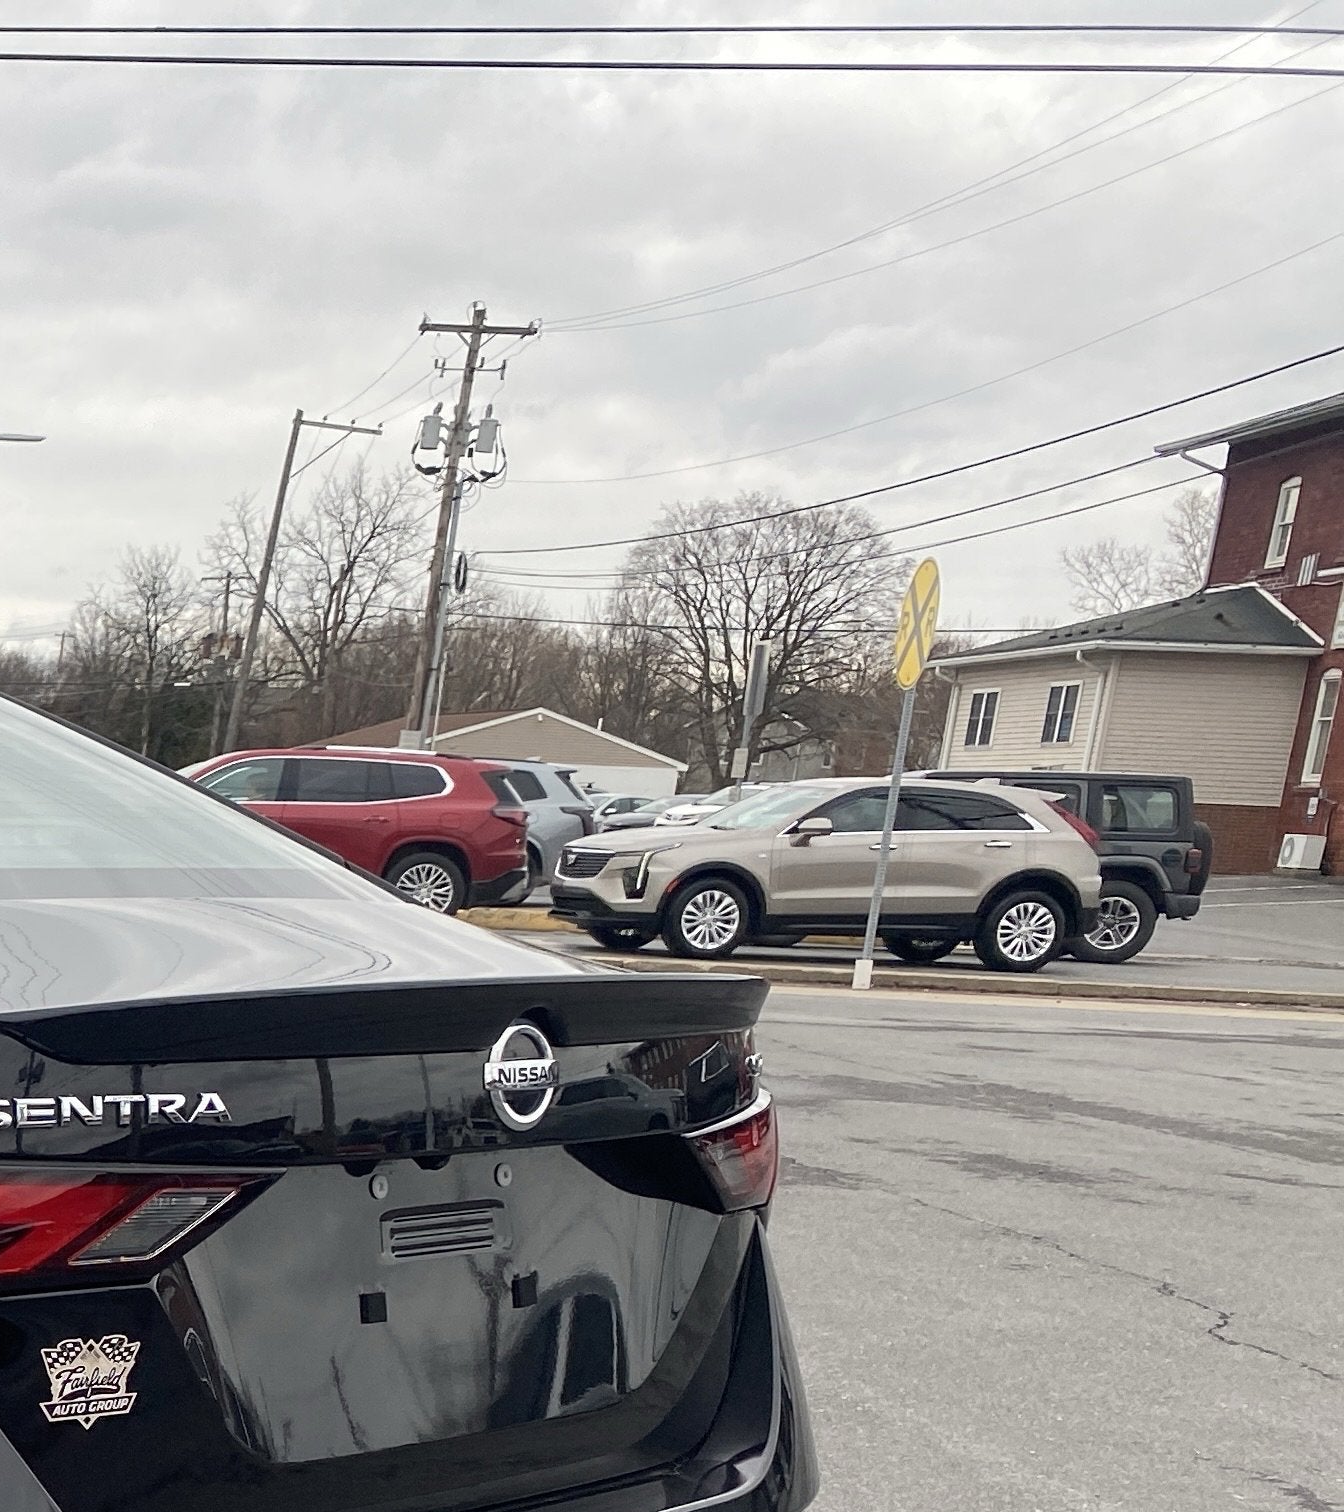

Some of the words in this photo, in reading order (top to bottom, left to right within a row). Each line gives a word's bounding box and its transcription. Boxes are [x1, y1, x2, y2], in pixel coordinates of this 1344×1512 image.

[497, 1062, 560, 1087] NISSAN
[55, 1366, 127, 1401] Fairfield
[52, 1402, 87, 1417] AUTO
[88, 1398, 130, 1413] GROUP
